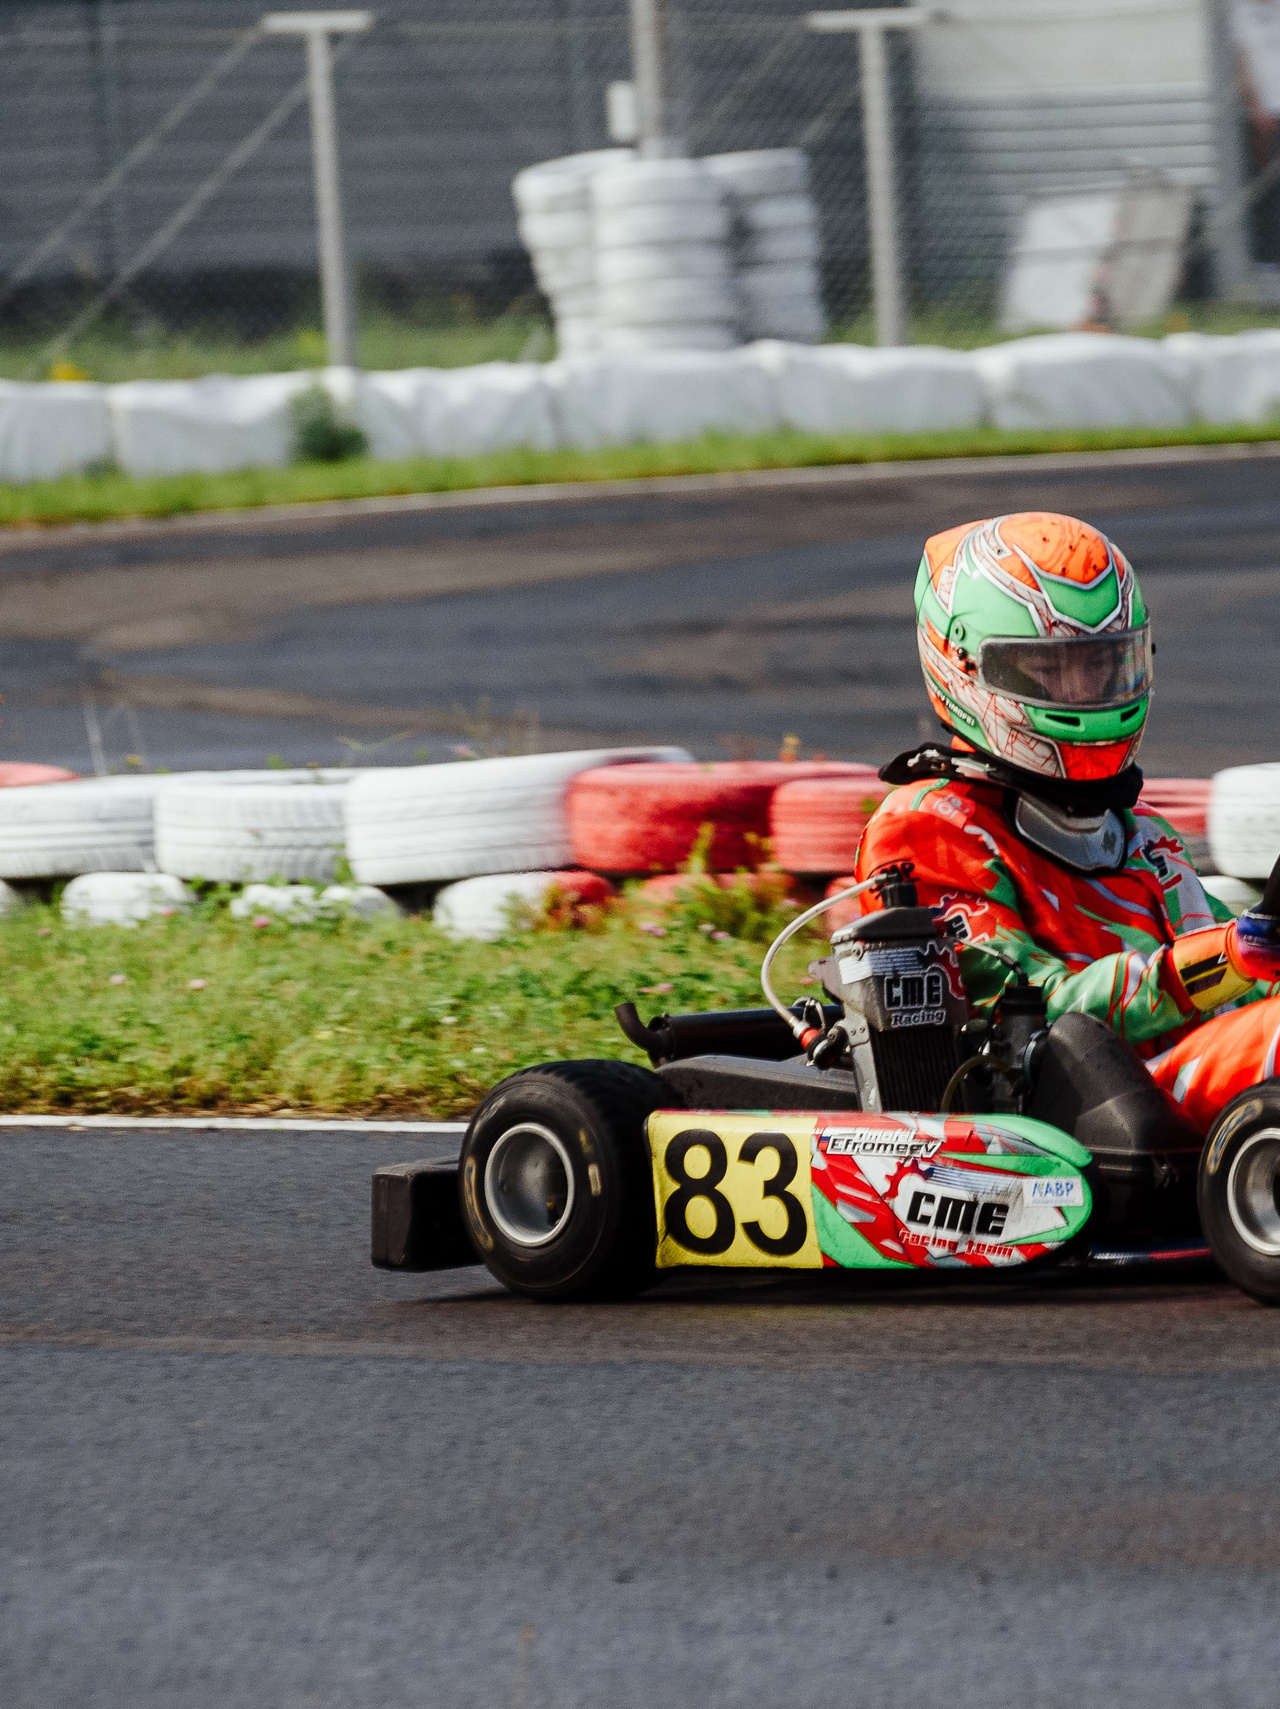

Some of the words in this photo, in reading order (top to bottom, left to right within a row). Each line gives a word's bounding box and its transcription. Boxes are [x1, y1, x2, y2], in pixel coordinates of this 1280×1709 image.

[884, 973, 942, 1010] CME
[826, 1136, 942, 1158] Efromeev
[664, 1129, 807, 1257] 83
[1032, 1181, 1074, 1197] NABP
[907, 1191, 1009, 1236] CME
